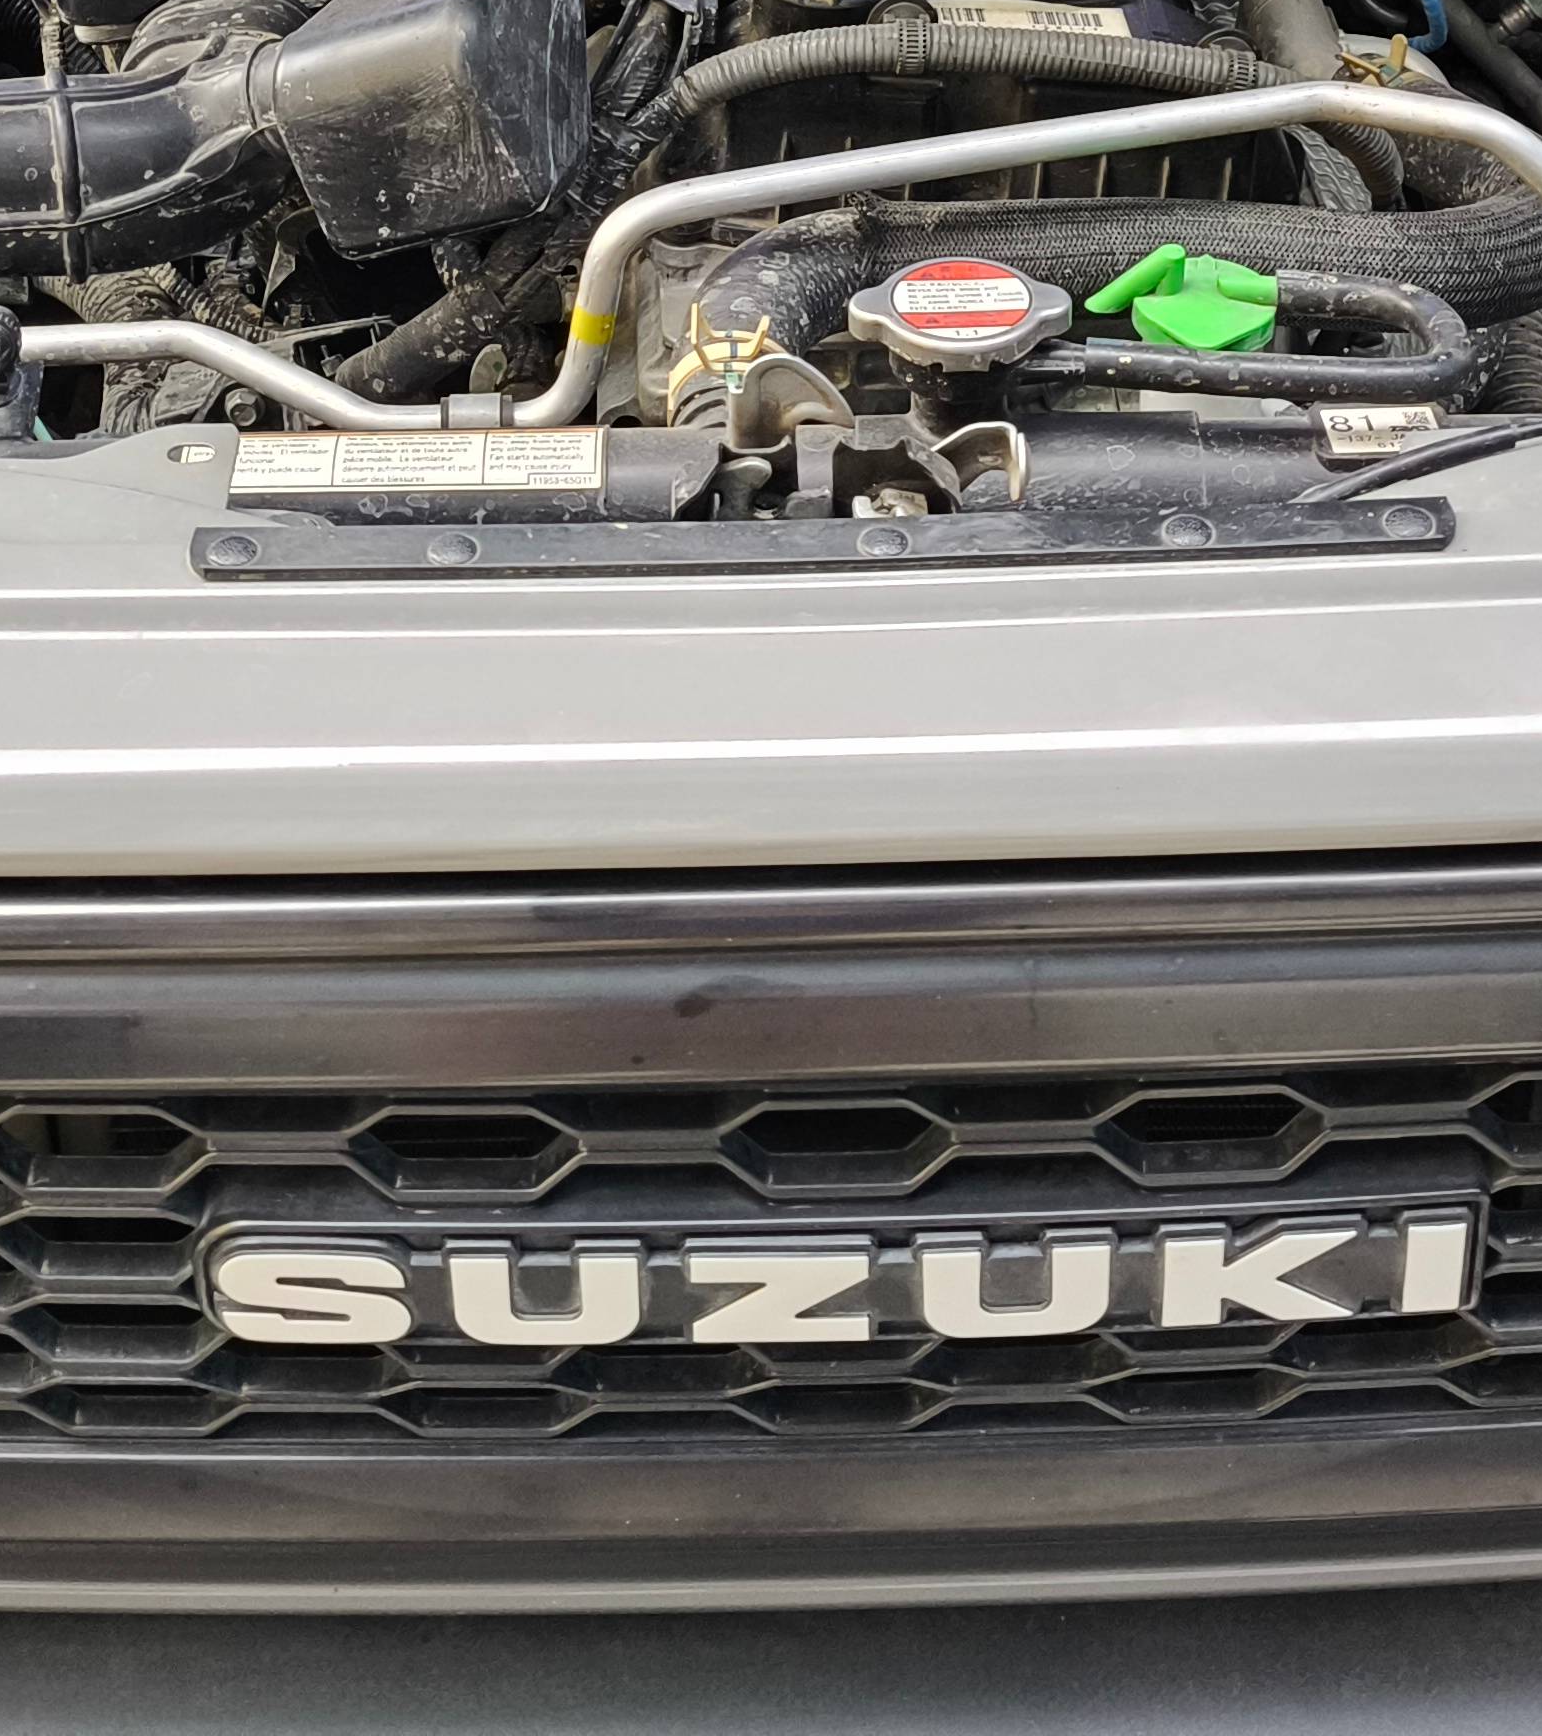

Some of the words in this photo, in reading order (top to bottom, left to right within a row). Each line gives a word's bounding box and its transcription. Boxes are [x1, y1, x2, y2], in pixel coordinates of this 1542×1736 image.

[1329, 414, 1375, 433] 81
[489, 453, 504, 461] Fan
[215, 1221, 1467, 1345] SUZUKI
